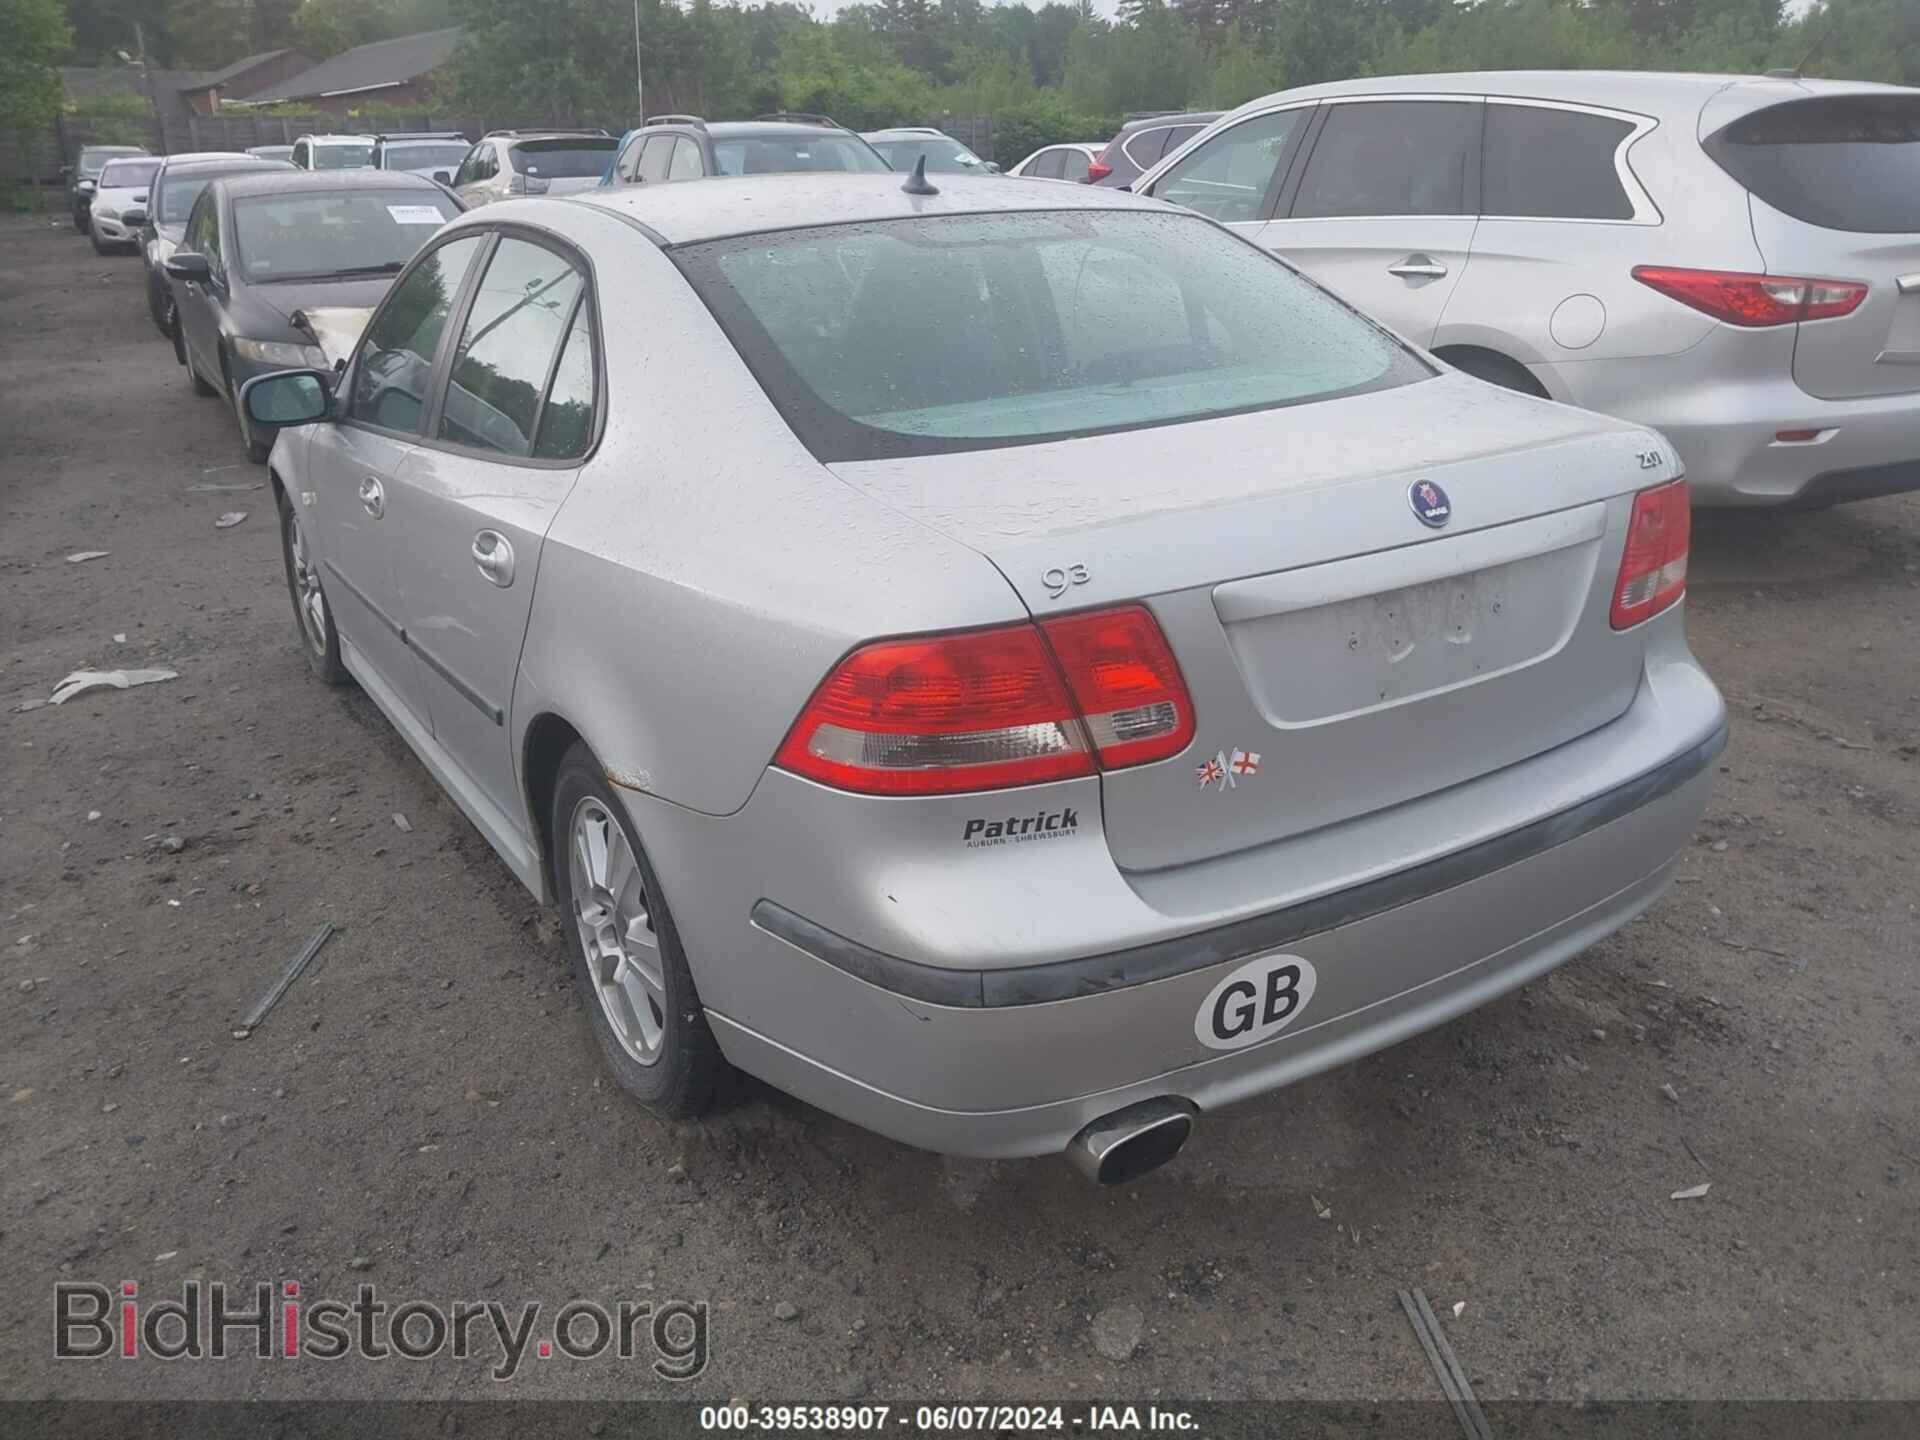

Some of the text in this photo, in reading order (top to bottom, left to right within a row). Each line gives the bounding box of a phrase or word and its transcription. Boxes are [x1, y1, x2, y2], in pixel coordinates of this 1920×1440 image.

[1041, 562, 1091, 599] 93
[963, 808, 1078, 840] Patrick
[967, 839, 1006, 849] AUBURN
[1015, 829, 1077, 843] SHREWSBURY
[1212, 965, 1301, 1040] GB
